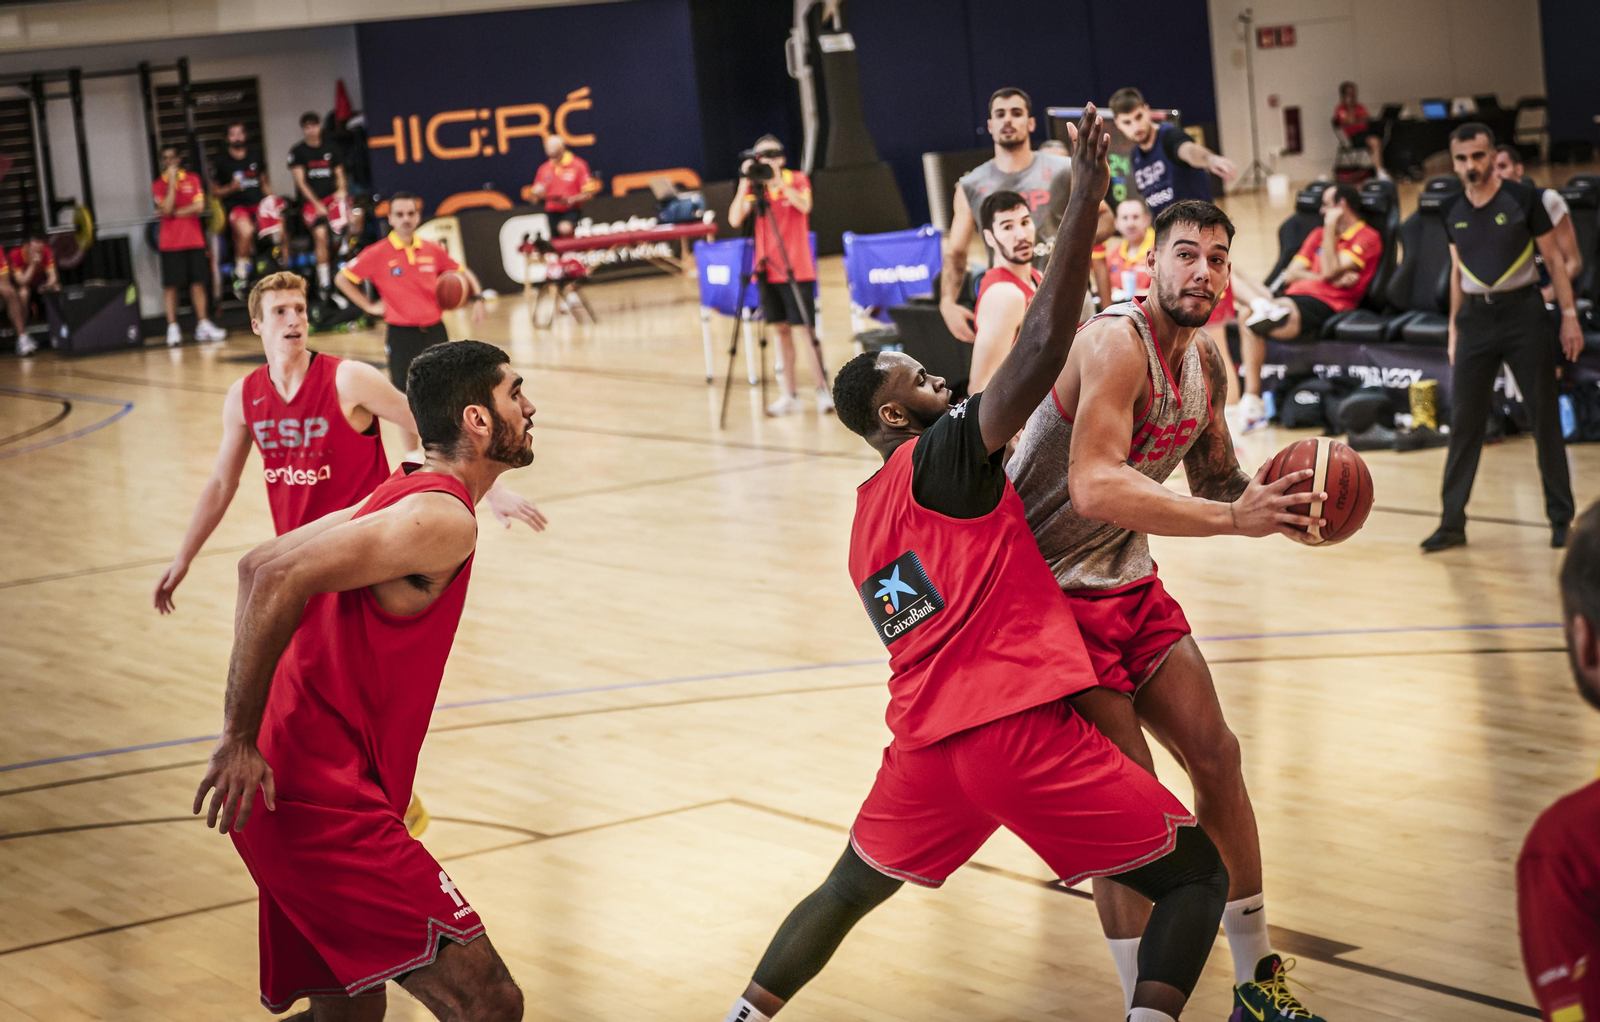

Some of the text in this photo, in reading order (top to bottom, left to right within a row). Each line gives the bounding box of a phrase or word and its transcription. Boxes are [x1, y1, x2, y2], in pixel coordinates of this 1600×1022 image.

[1134, 159, 1166, 190] ESP
[252, 416, 329, 450] ESP
[1128, 417, 1198, 464] ESP
[264, 464, 331, 486] endesa
[1335, 462, 1351, 511] molten
[883, 599, 936, 639] CaixaBank
[438, 870, 468, 908] f
